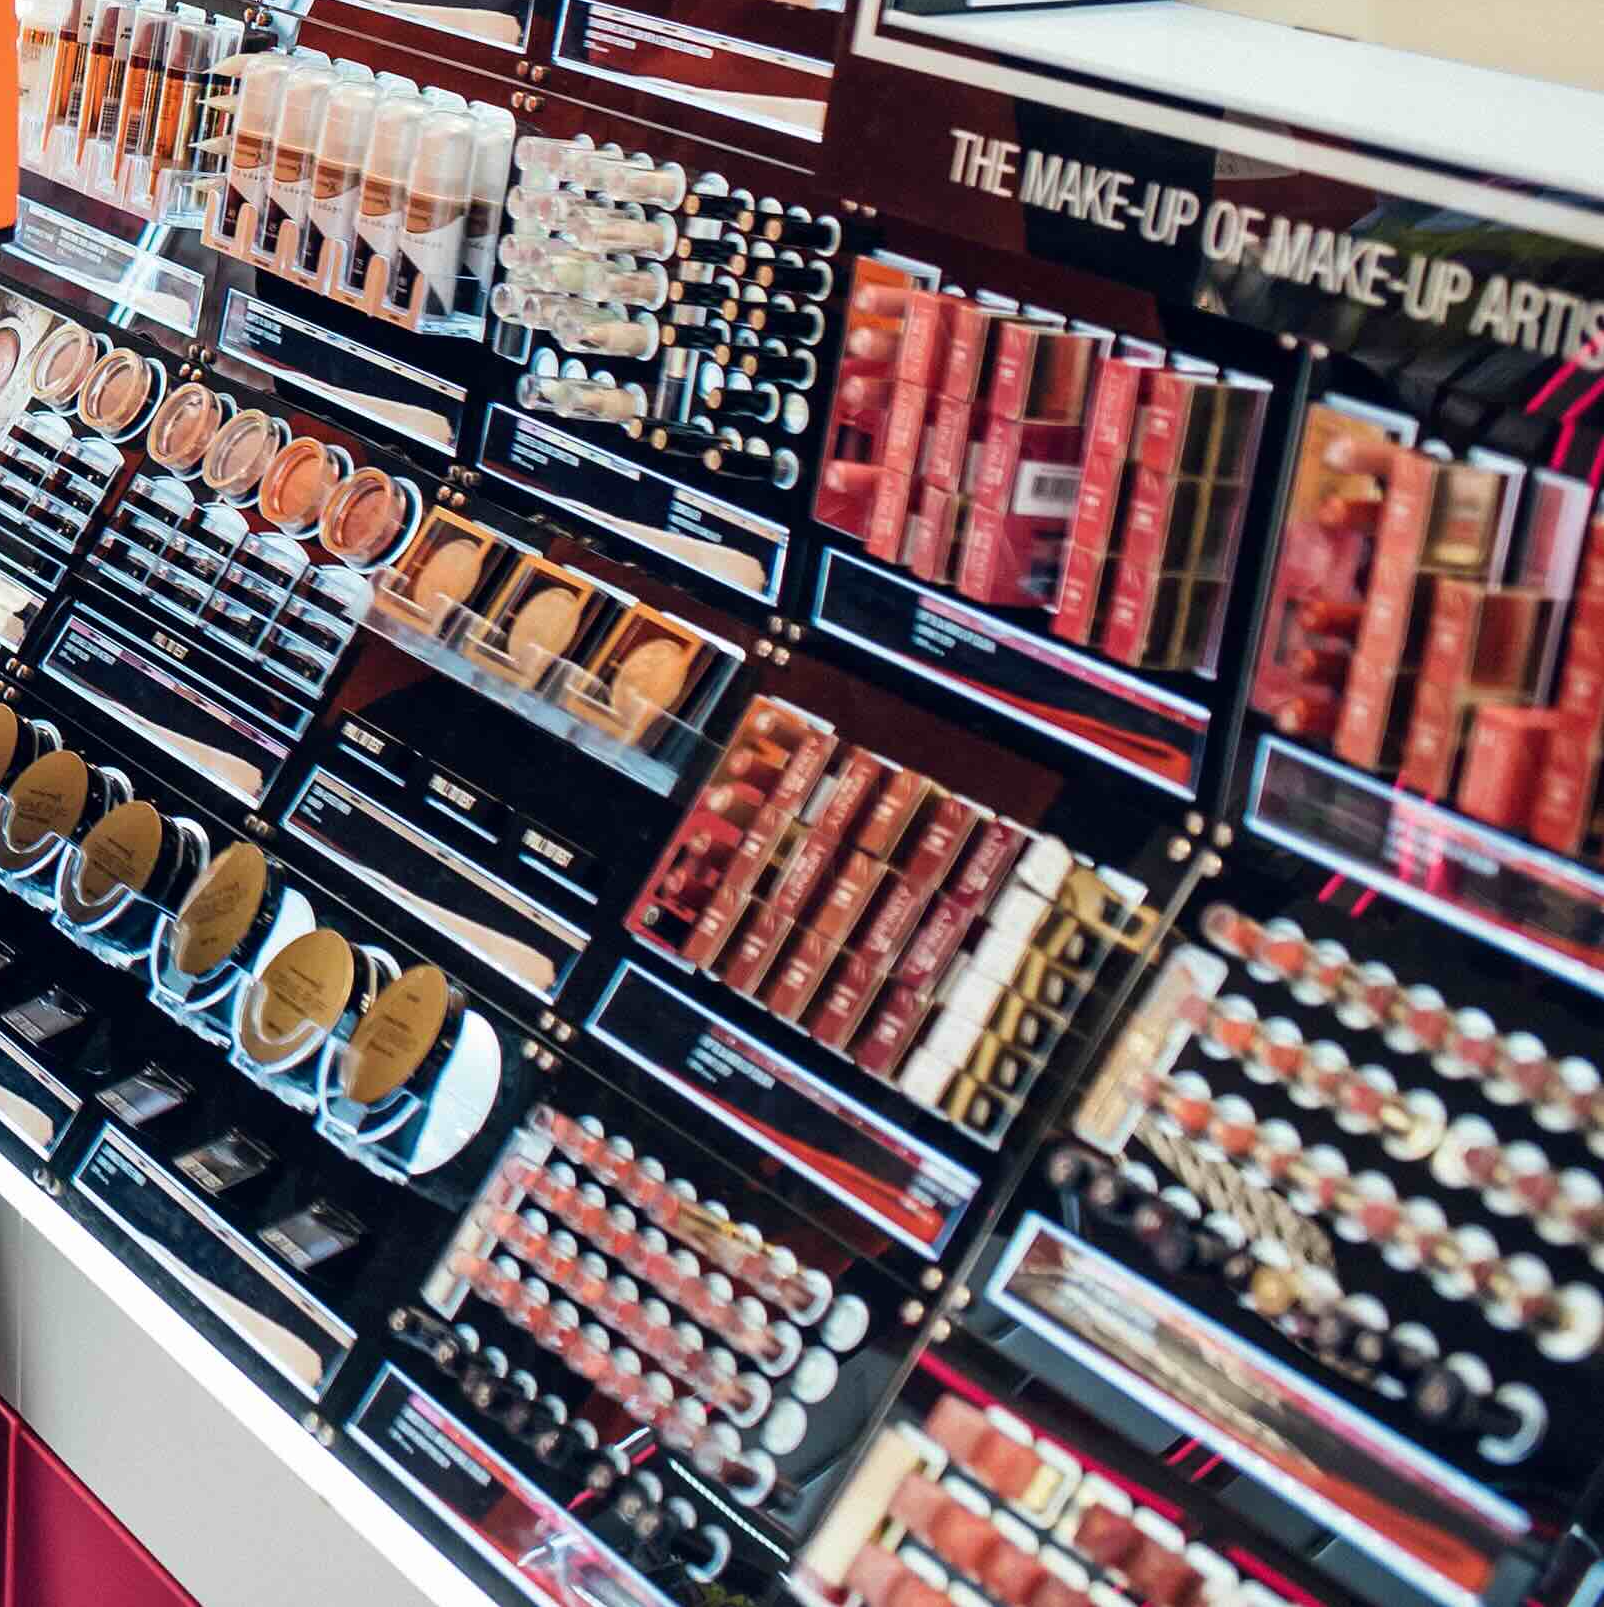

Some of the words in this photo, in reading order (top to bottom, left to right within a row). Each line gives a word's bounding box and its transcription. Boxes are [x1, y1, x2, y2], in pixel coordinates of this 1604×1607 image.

[948, 127, 1022, 199] THE
[1019, 150, 1201, 247] MAKE-UP
[1201, 198, 1267, 265] OF
[1261, 215, 1473, 324] MAKE-UP
